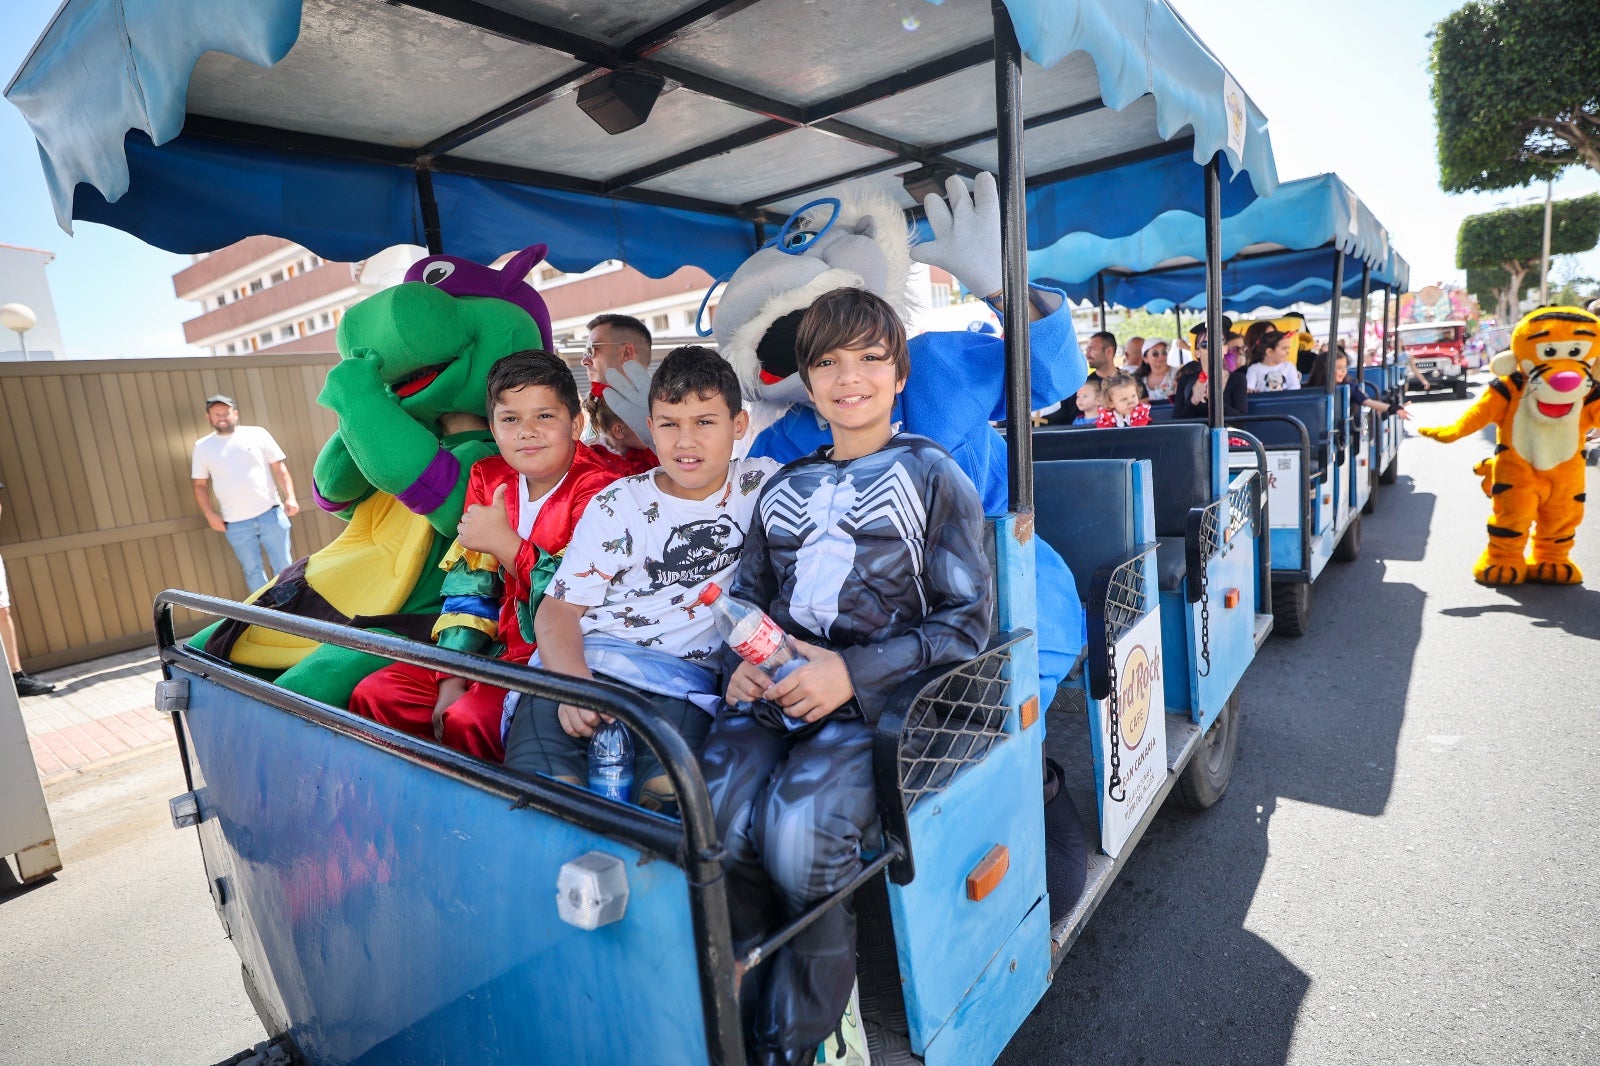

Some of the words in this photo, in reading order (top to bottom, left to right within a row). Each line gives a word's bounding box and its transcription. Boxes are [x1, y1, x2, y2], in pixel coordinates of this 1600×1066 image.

[1136, 646, 1160, 699] Rock
[1129, 708, 1143, 733] CAFE
[1118, 765, 1134, 793] GRAN
[1134, 737, 1156, 771] CANARIA
